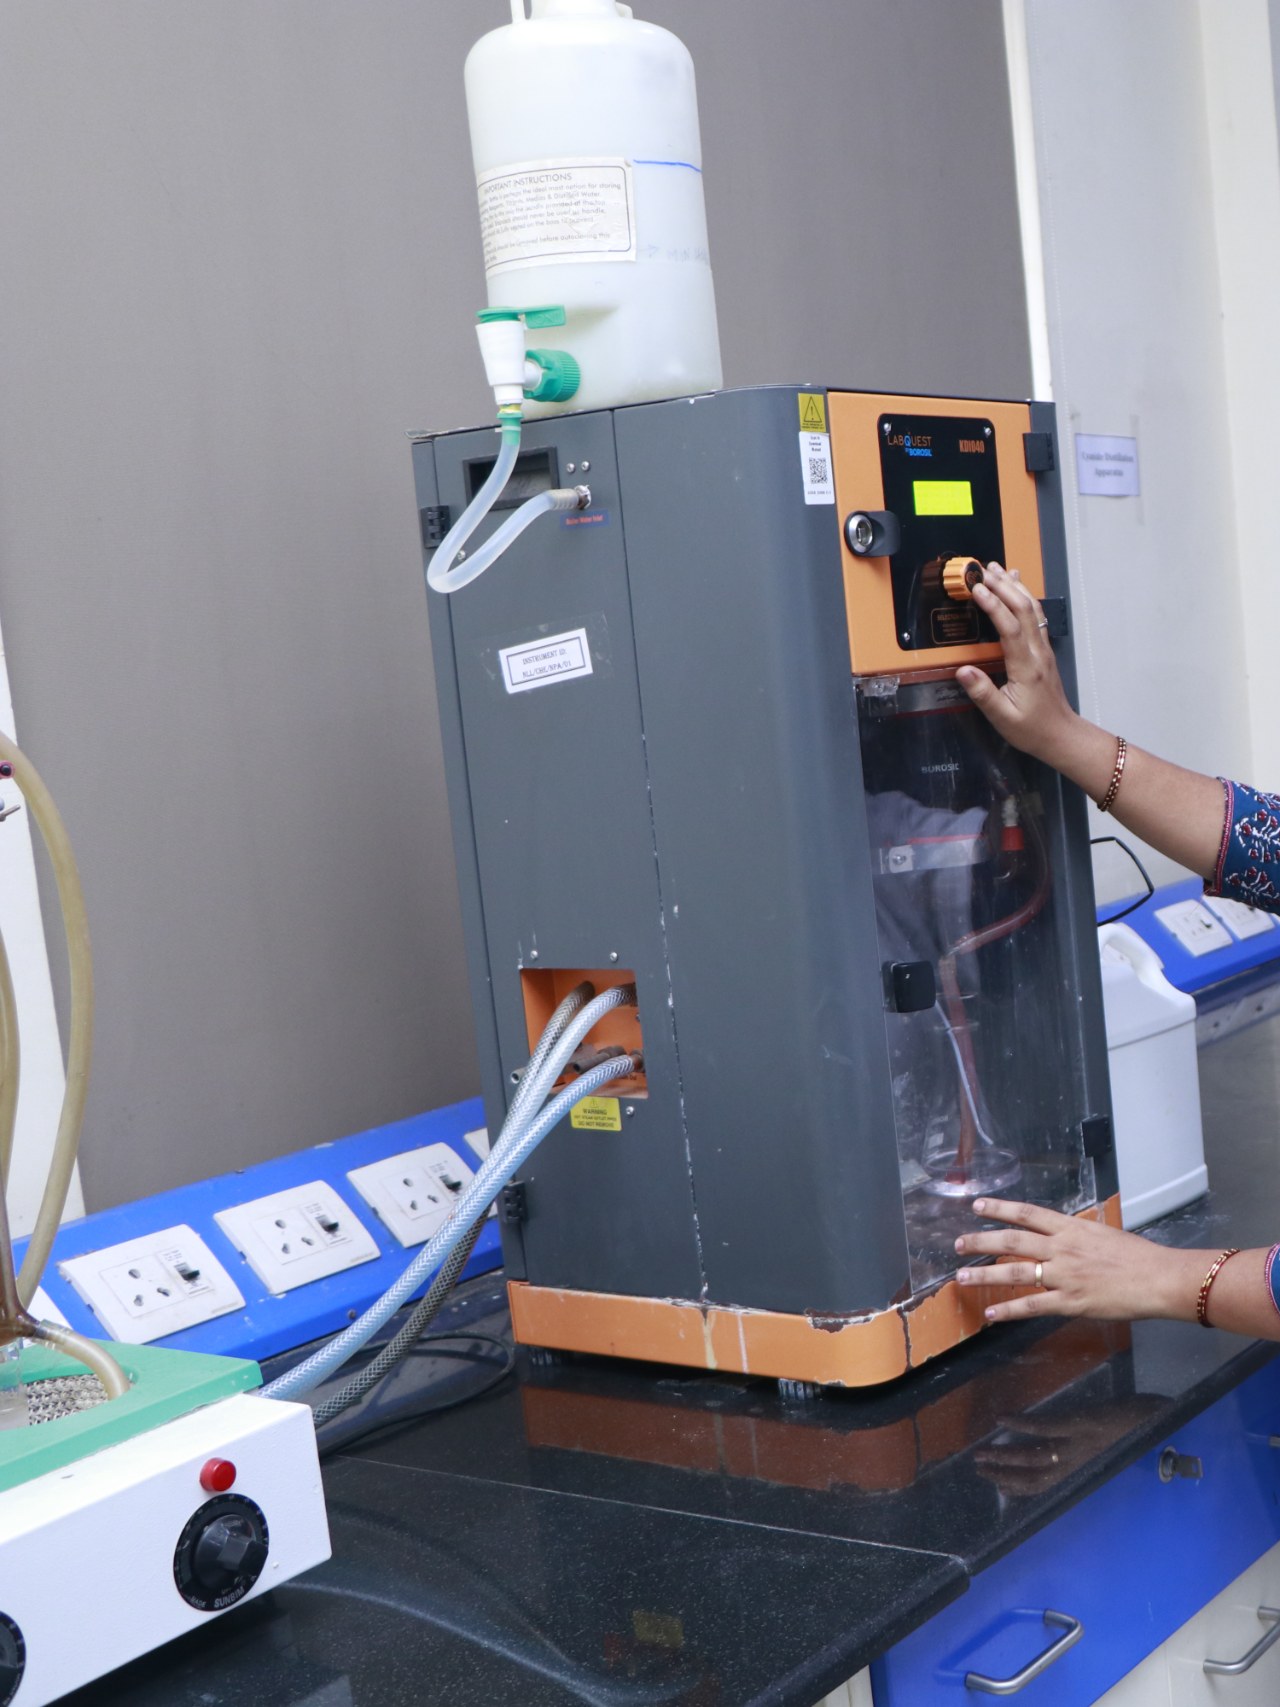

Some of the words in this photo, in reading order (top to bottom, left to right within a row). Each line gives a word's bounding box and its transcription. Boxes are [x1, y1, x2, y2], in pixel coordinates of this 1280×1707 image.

[514, 173, 572, 186] INSTRUCTIONS
[887, 434, 932, 447] LABQUEST
[908, 448, 933, 457] BOROSIL
[522, 650, 558, 665] INSTRUMENT
[921, 762, 960, 774] BOROSIL
[583, 1108, 607, 1116] WARNING
[213, 1585, 245, 1608] SUNBIM
